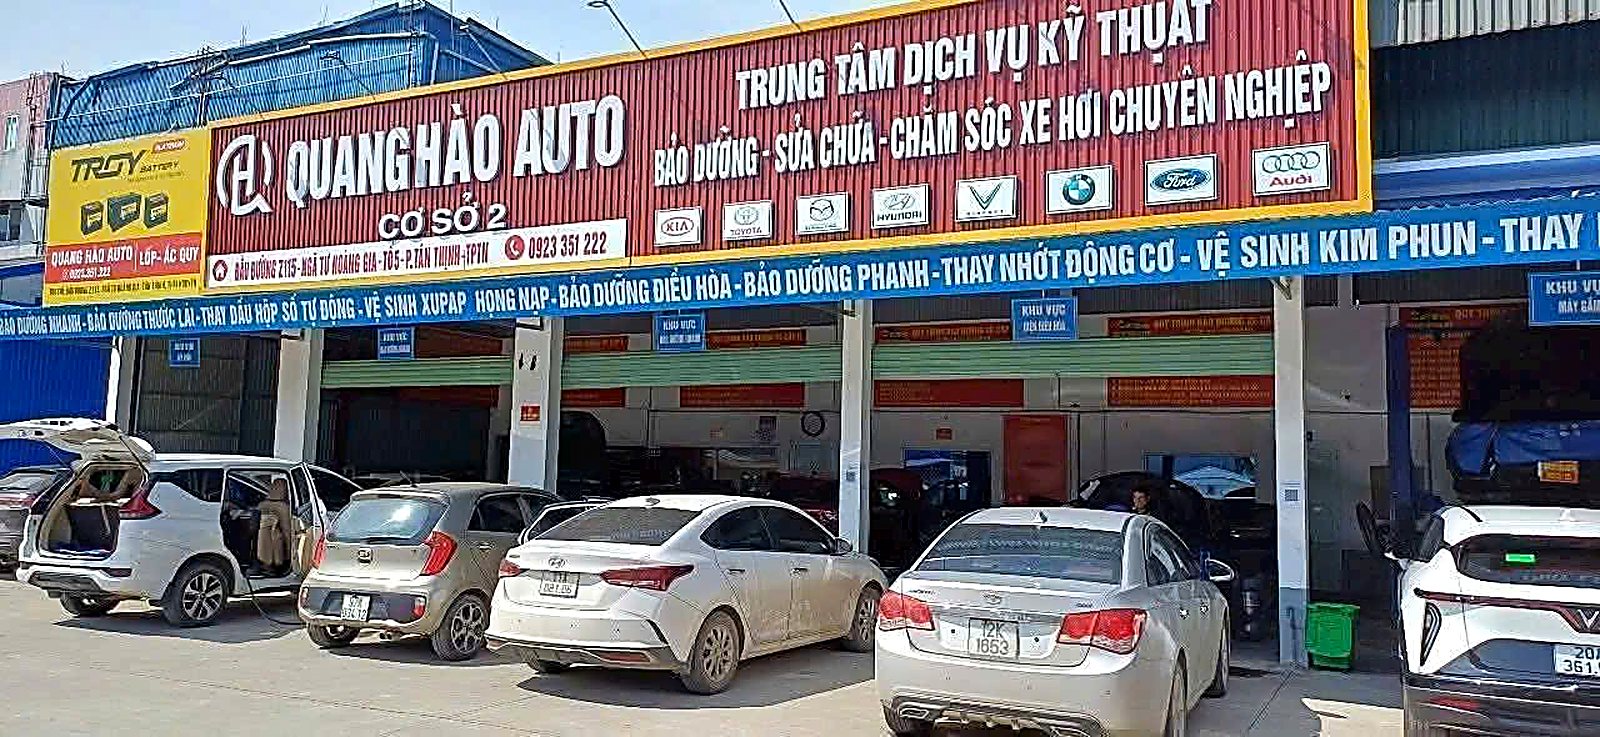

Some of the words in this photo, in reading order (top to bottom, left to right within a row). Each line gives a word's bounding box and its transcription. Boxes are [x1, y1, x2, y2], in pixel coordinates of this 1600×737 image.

[736, 58, 825, 111] TRUNG
[835, 41, 896, 96] TÂM
[903, 33, 976, 95] DỊCH
[986, 25, 1030, 82] VỤ
[1038, 4, 1085, 66] KỸ
[655, 131, 689, 187] BẢO
[694, 125, 759, 181] DƯỠNG
[775, 114, 816, 173] SỬA
[820, 110, 875, 168] CHỮA
[890, 102, 957, 160] CHĂM
[964, 97, 1012, 151] SÓC
[1019, 89, 1051, 145] XE
[1059, 82, 1101, 141] HƠI
[1110, 65, 1216, 135] CHUYÊN
[1224, 49, 1331, 129] NGHIỆP
[512, 94, 624, 178] AUTO
[71, 150, 149, 182] TROY
[1164, 171, 1197, 188] Ford
[1270, 174, 1313, 187] Audi
[378, 207, 425, 235] CƠ
[431, 190, 480, 233] SỞ
[488, 202, 507, 231] 2
[877, 211, 923, 221] HYUNDAI
[666, 221, 688, 231] KIA
[730, 226, 762, 236] TOYOTA
[530, 235, 557, 259] 0923
[561, 233, 579, 257] 351
[584, 231, 607, 255] 222
[52, 249, 83, 267] QUANG
[108, 245, 133, 261] AUTO
[50, 314, 81, 333] NHANH
[200, 306, 226, 327] THAY
[255, 299, 278, 328] HỘP
[282, 292, 298, 321] SỐ
[300, 297, 317, 327] TỰ
[319, 293, 355, 326] ĐỘNG
[364, 291, 381, 323] VỆ
[384, 293, 417, 318] SINH
[421, 290, 467, 316] XUPAP
[475, 287, 516, 319] HỌNG
[518, 286, 550, 316] NẠP
[558, 275, 590, 309] BẢO
[593, 273, 650, 307] DƯỠNG
[652, 267, 692, 303] ĐIỀU
[695, 268, 732, 301] HÒA
[743, 261, 782, 297] BẢO
[785, 258, 853, 295] DƯỠNG
[857, 259, 930, 291] PHANH
[940, 254, 994, 286] THAY
[999, 241, 1061, 282] NHỚT
[1065, 240, 1135, 284] ĐỘNG
[1139, 238, 1175, 274] CƠ
[1196, 230, 1231, 277] VỆ
[1240, 231, 1309, 268] SINH
[1319, 228, 1378, 264] KIM
[1388, 220, 1476, 260] PHUN
[1499, 213, 1584, 253] THAY
[1546, 280, 1577, 294] KHU
[1022, 304, 1043, 317] KHU
[981, 621, 1005, 640] 12K
[1563, 659, 1600, 674] 361.
